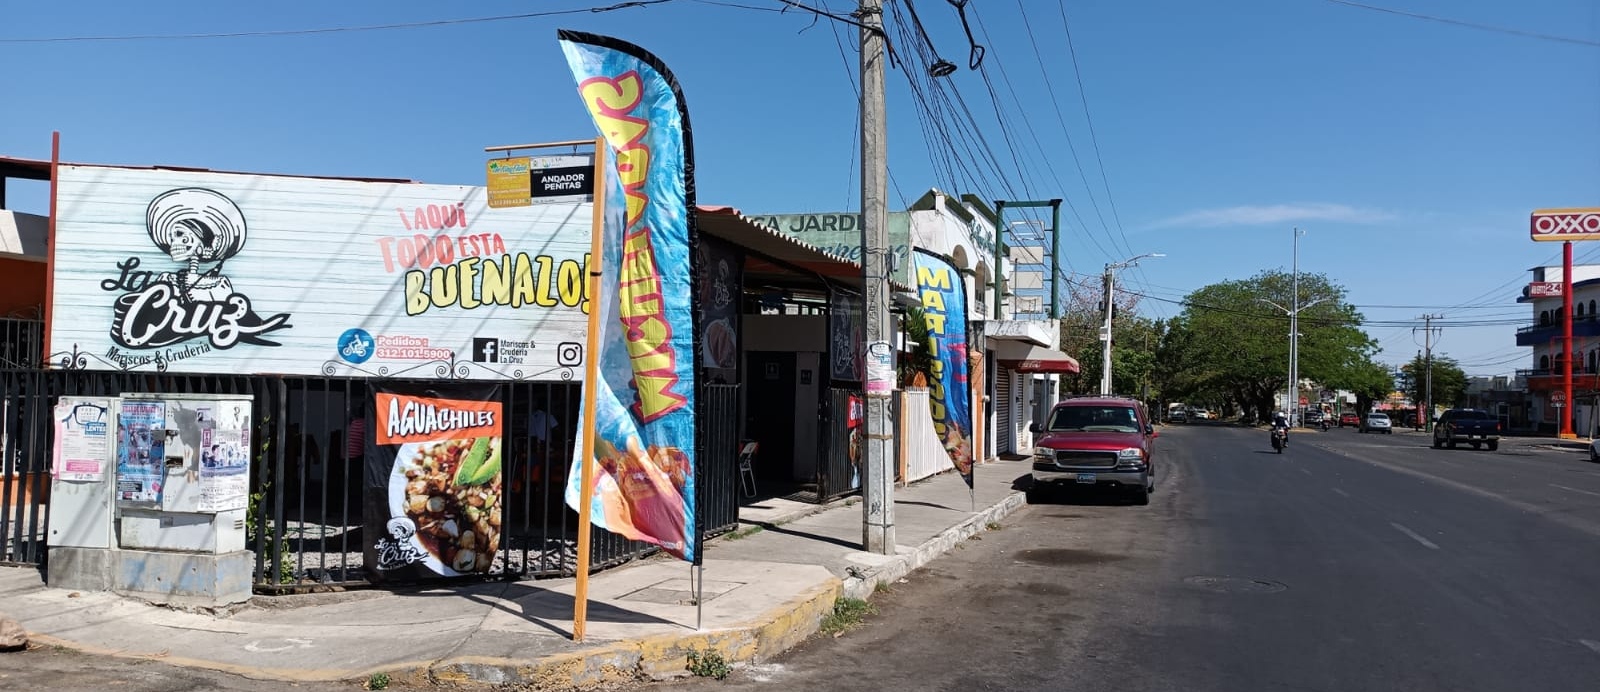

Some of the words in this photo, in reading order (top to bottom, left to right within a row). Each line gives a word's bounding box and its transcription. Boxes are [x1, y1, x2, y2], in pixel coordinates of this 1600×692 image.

[541, 173, 585, 184] ANDADOR
[788, 214, 862, 232] JARDI
[1535, 214, 1600, 235] OXXO
[375, 233, 455, 273] TODO
[458, 233, 506, 258] ESTA
[100, 256, 156, 292] La
[120, 282, 284, 347] Cruz
[377, 335, 422, 347] Pedidos
[500, 340, 529, 348] Mariscos
[530, 340, 536, 348] &
[105, 345, 151, 365] Mariscos
[155, 349, 163, 364] &
[508, 356, 523, 364] Cruz
[387, 397, 495, 438] AGUACHILES
[381, 545, 428, 565] Cruz
